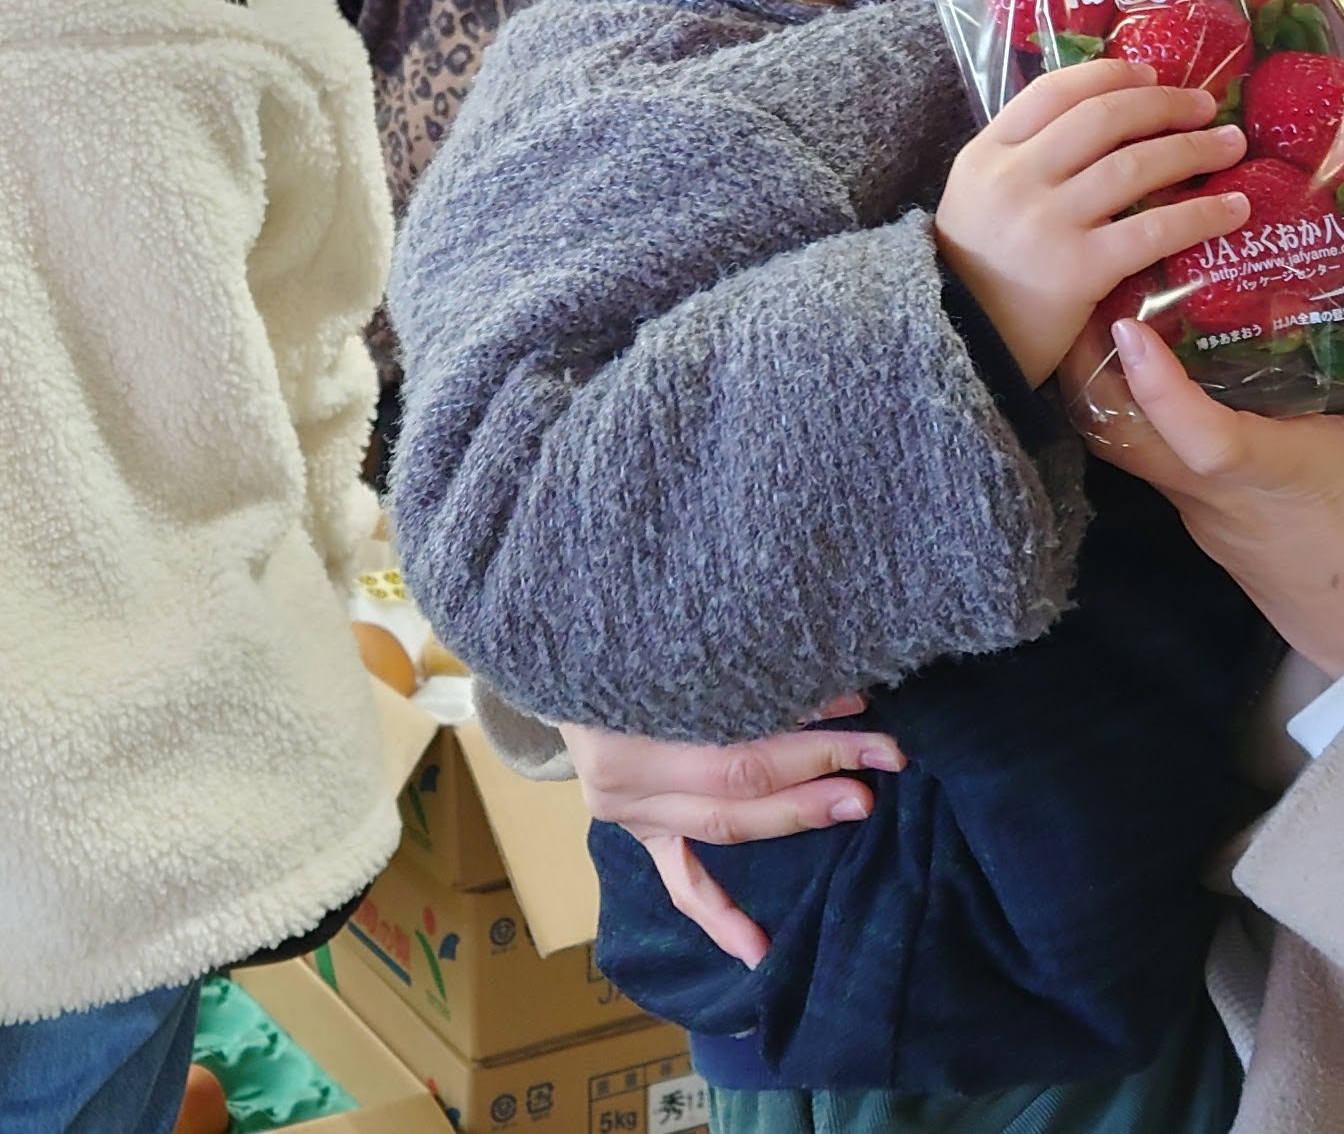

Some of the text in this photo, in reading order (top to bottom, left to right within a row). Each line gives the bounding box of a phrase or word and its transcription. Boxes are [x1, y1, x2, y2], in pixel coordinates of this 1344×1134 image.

[1235, 263, 1342, 293] パッケージセンター
[1195, 323, 1264, 352] 博多あまおう
[599, 1110, 638, 1134] 5kg
